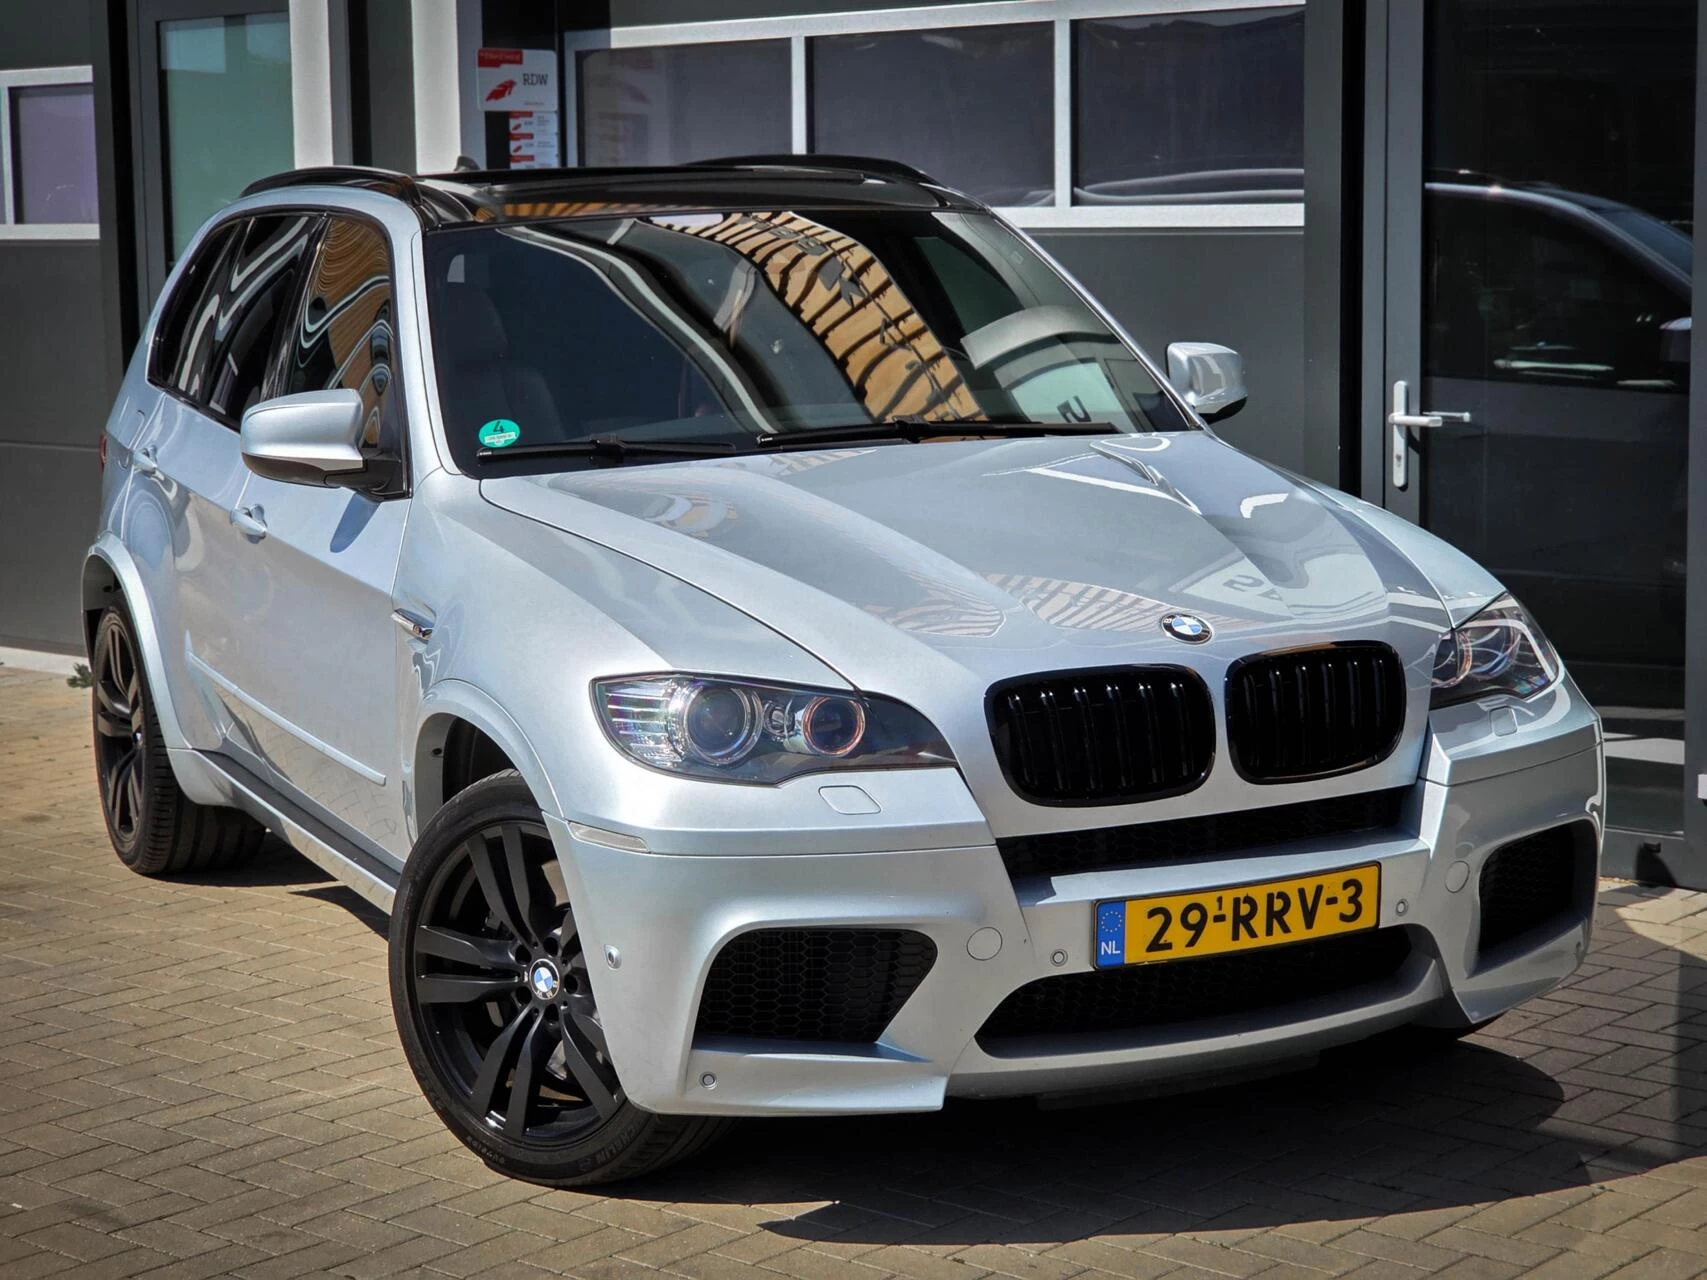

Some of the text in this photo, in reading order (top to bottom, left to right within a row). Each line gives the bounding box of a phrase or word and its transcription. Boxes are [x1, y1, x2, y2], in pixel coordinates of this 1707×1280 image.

[522, 73, 549, 86] RDW
[493, 420, 504, 433] 4
[1145, 877, 1364, 954] 29-RRV-3
[1100, 940, 1120, 956] NL
